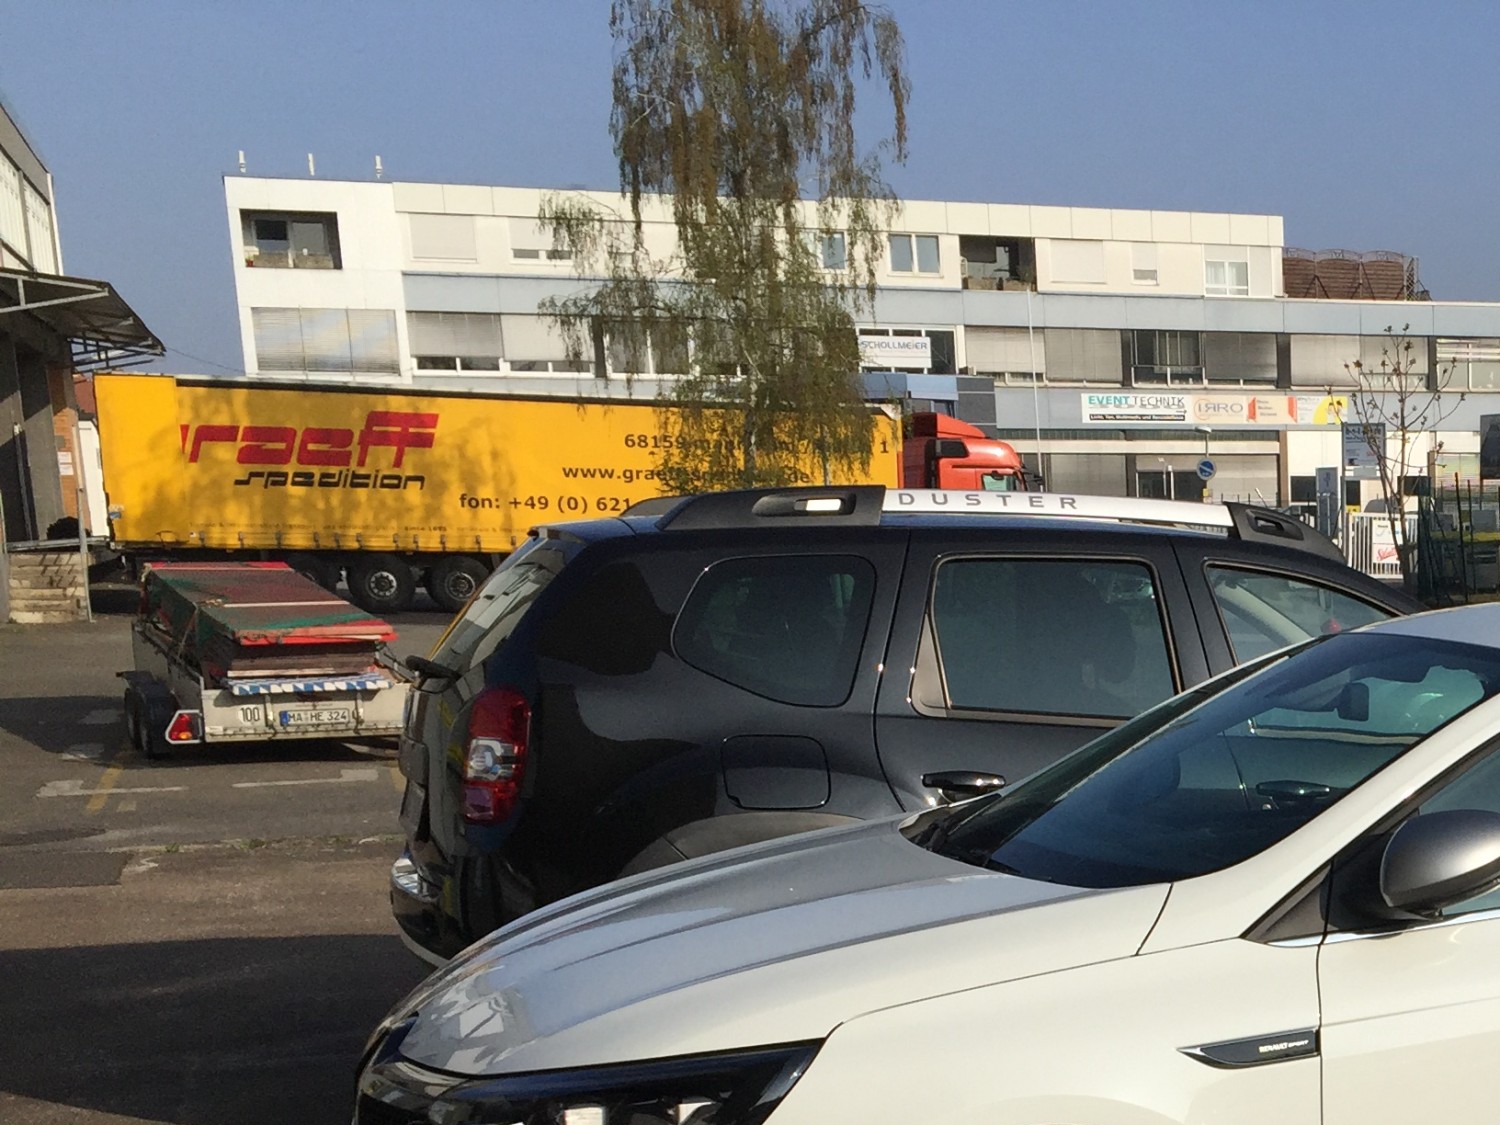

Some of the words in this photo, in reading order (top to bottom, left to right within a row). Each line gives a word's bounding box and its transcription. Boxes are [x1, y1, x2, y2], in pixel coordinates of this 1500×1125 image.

[180, 411, 439, 468] raeff
[234, 468, 426, 490] spedition
[459, 494, 500, 509] fon:
[508, 496, 549, 510] +49
[557, 496, 588, 514] (0)
[898, 493, 1078, 509] DUSTER
[241, 707, 260, 721] 100
[288, 712, 303, 722] MA
[310, 711, 324, 721] HE
[327, 710, 347, 721] 324
